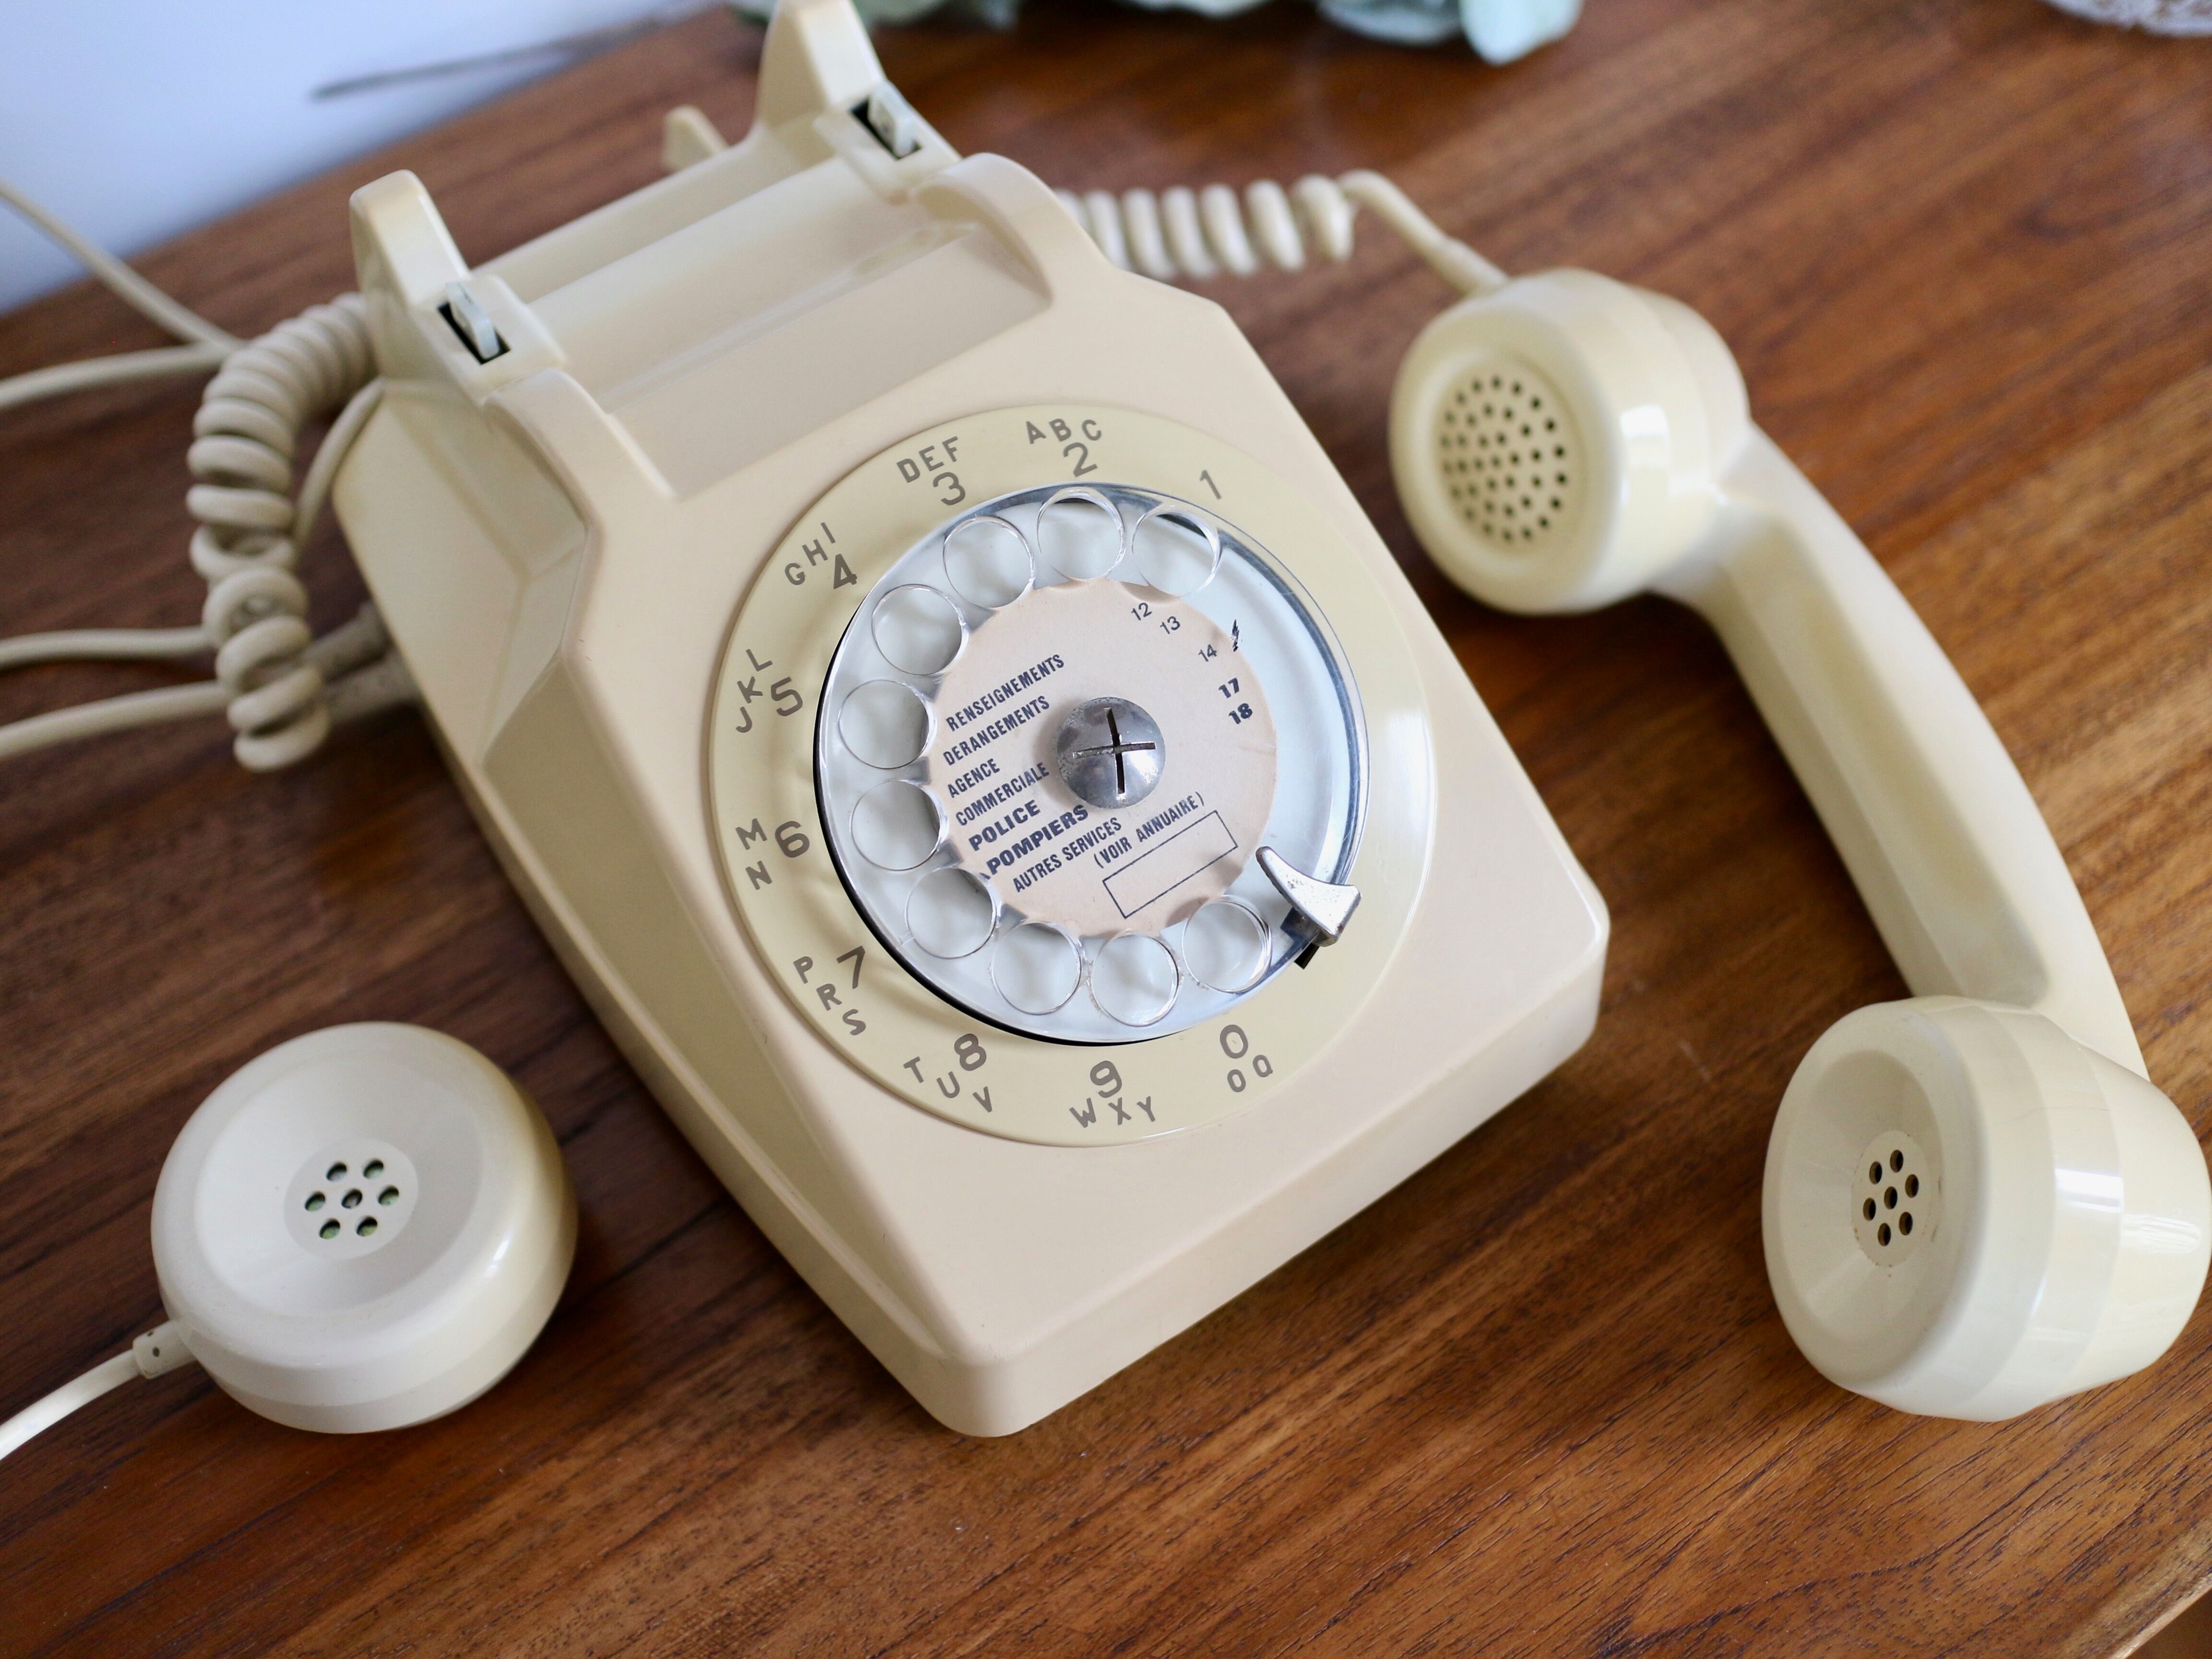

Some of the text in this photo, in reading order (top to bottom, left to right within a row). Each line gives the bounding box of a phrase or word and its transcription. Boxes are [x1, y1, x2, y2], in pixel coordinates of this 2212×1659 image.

[897, 436, 960, 483] DEF
[1063, 442, 1097, 477] 2
[932, 472, 966, 505] 3
[1200, 470, 1222, 500] 1
[833, 553, 857, 590] 4
[1131, 602, 1153, 621] 12
[1160, 616, 1181, 635] 13
[1198, 644, 1217, 662] 14
[770, 676, 803, 717] 5
[945, 654, 1065, 732] RENSEIGNEMENTS
[1218, 677, 1240, 698] 17
[943, 695, 1050, 766] DERANGEMENTS
[1228, 703, 1253, 725] 18
[947, 758, 1000, 798] AGENCE
[955, 762, 1050, 826] COMMERCIALE
[774, 820, 810, 858] 6
[968, 799, 1041, 852] POLICE
[986, 804, 1089, 875] POMPIERS
[1094, 791, 1205, 869] (VOIR ANNUAIRE)
[1012, 817, 1122, 892] AUTRES SERVICES
[836, 945, 866, 989] 7
[953, 1033, 987, 1071] 8
[1219, 1024, 1249, 1059] 0
[1089, 1060, 1122, 1098] 9
